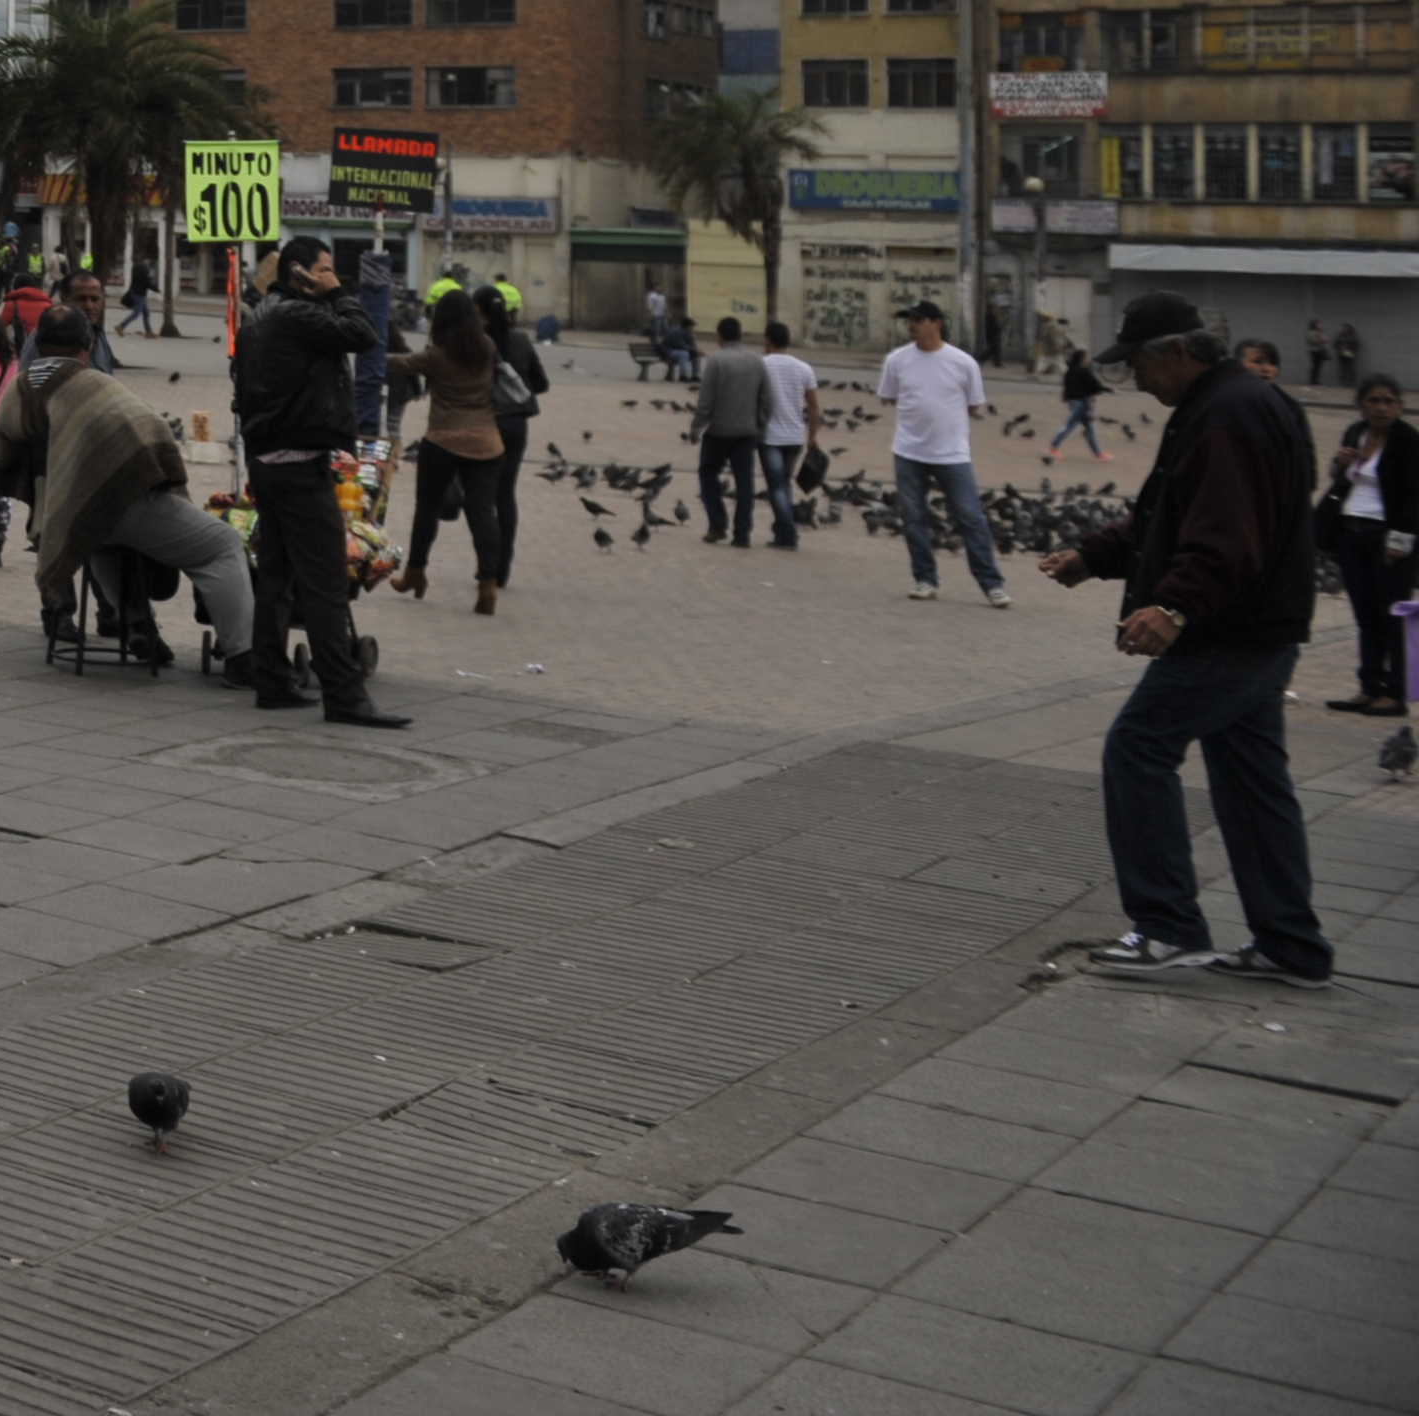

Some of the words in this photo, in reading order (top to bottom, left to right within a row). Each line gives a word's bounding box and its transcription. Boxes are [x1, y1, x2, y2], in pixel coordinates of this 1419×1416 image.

[338, 134, 436, 158] LLAMADA
[192, 152, 271, 176] MINUTO
[332, 166, 434, 190] INTERNACIONAL
[816, 172, 960, 200] DROGUERIA
[193, 181, 270, 238] $100
[470, 219, 552, 230] POPULAR
